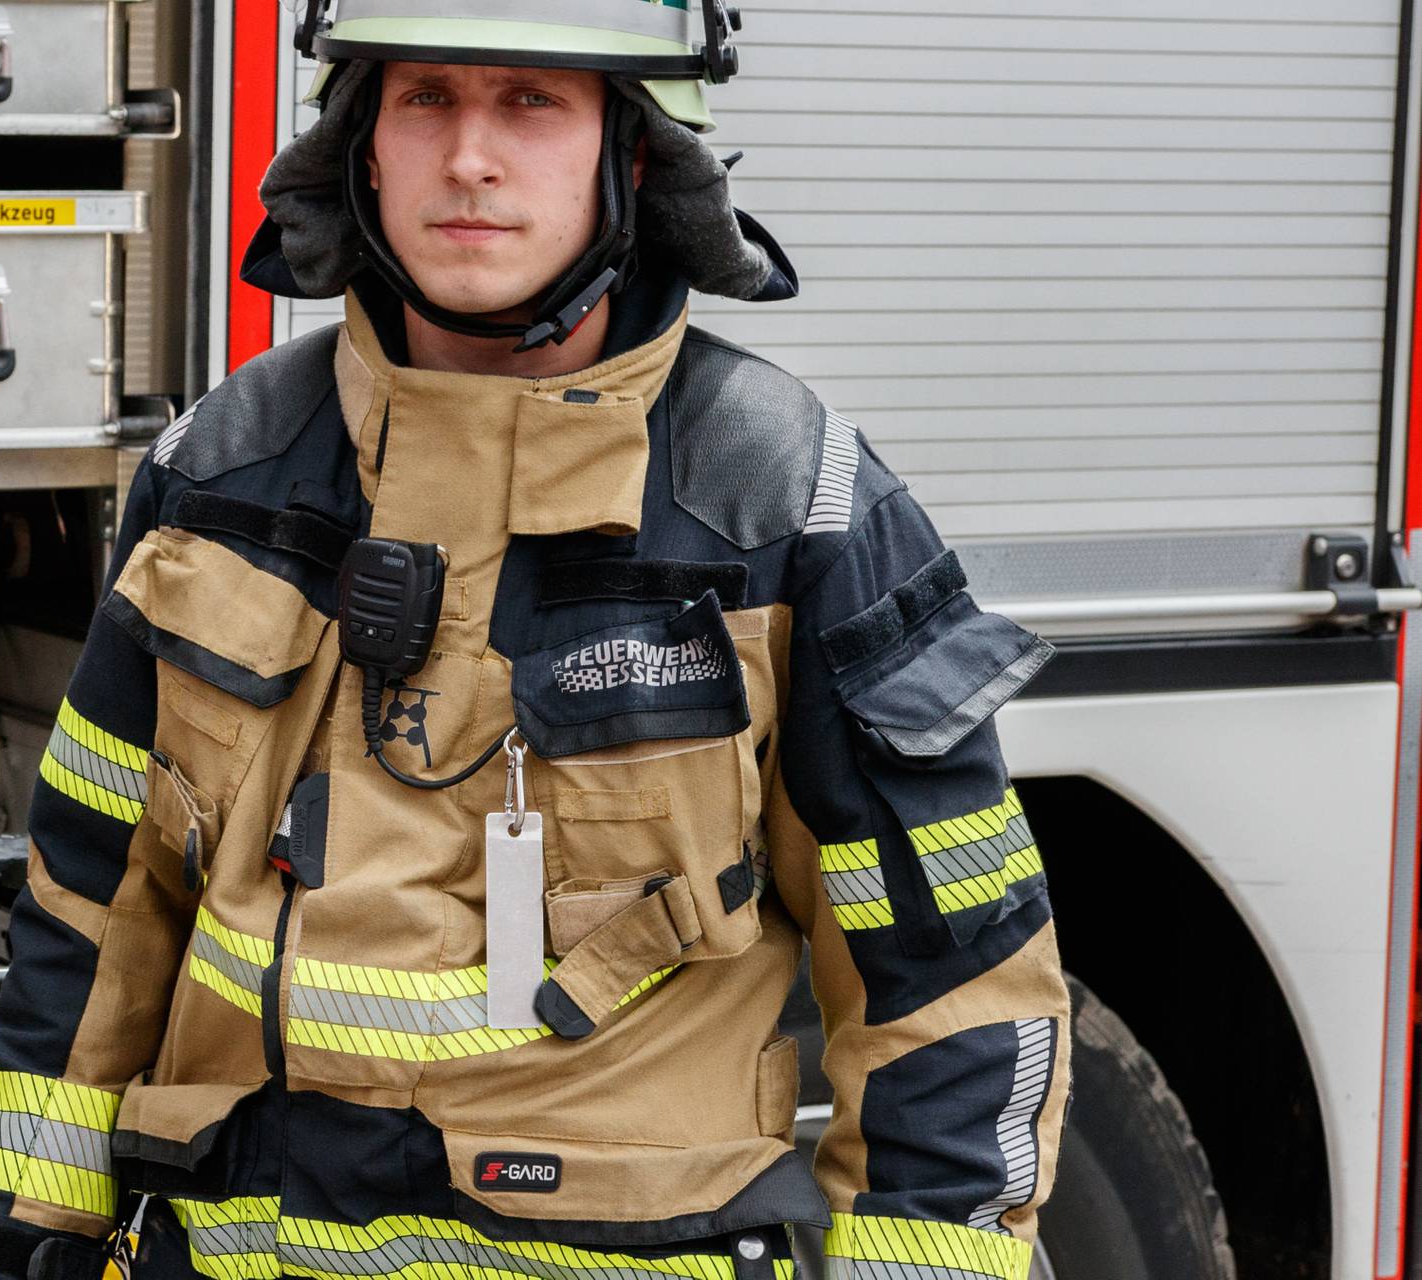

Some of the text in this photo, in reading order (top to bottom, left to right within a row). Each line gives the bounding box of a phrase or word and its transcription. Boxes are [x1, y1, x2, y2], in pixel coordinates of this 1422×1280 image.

[565, 638, 709, 668] FEUERWEHR
[605, 661, 677, 689] ESSEN
[481, 1162, 556, 1181] S-GARD
